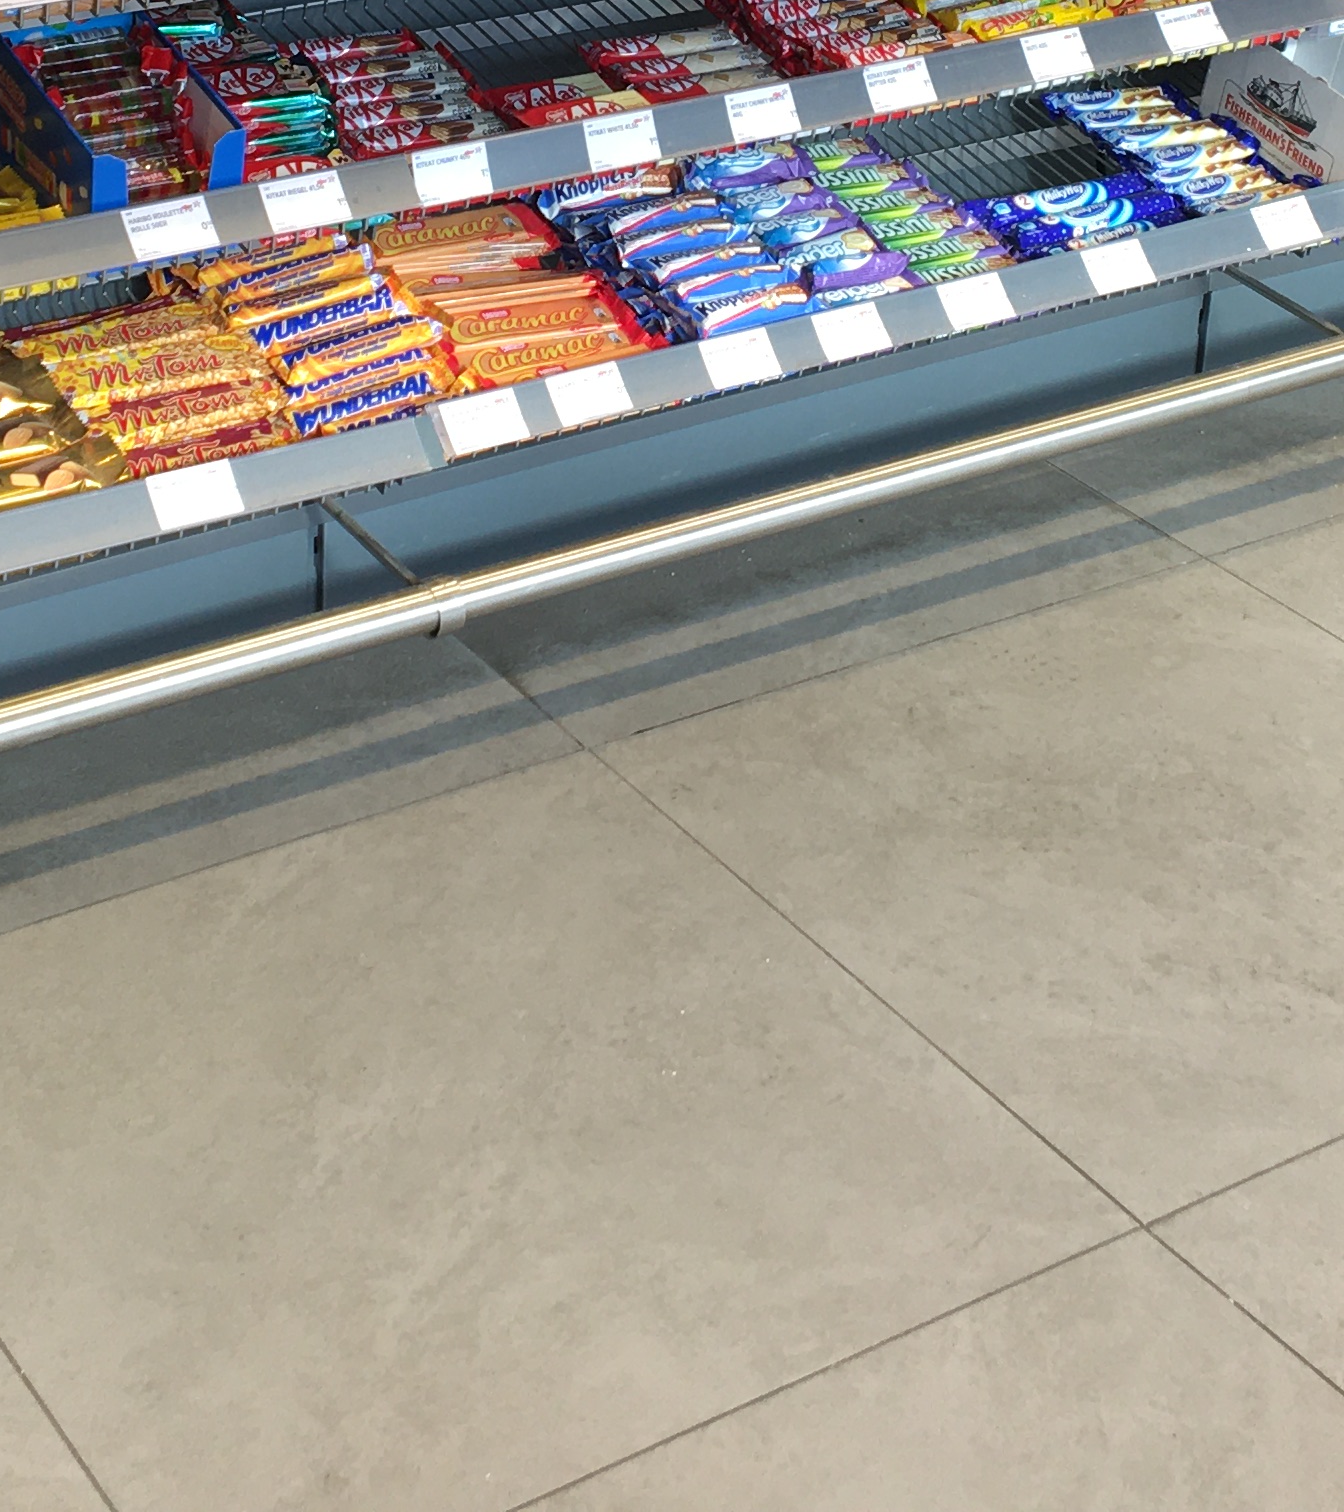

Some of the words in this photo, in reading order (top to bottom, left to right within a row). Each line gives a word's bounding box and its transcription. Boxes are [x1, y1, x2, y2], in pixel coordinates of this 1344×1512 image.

[1224, 94, 1288, 154] FISHERMAN'S
[1285, 137, 1325, 179] FRIEND
[250, 288, 394, 349] WUNDERBAR
[450, 306, 586, 344] Caramac
